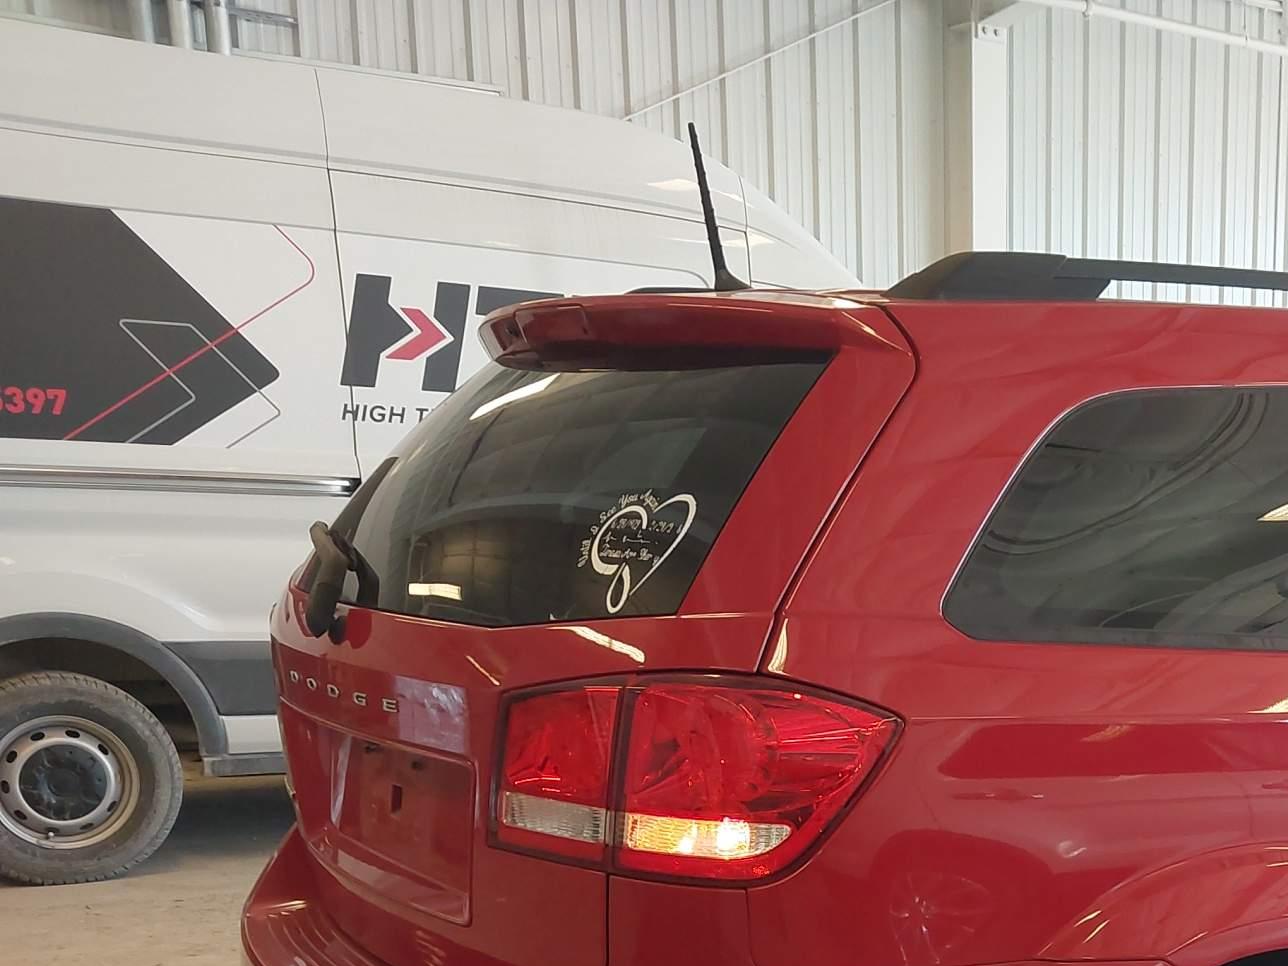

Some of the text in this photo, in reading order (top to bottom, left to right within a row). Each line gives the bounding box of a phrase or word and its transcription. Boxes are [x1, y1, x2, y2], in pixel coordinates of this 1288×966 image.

[0, 386, 66, 415] 397
[341, 403, 433, 423] HIGH T
[618, 493, 639, 509] You
[289, 670, 399, 713] DODGE
